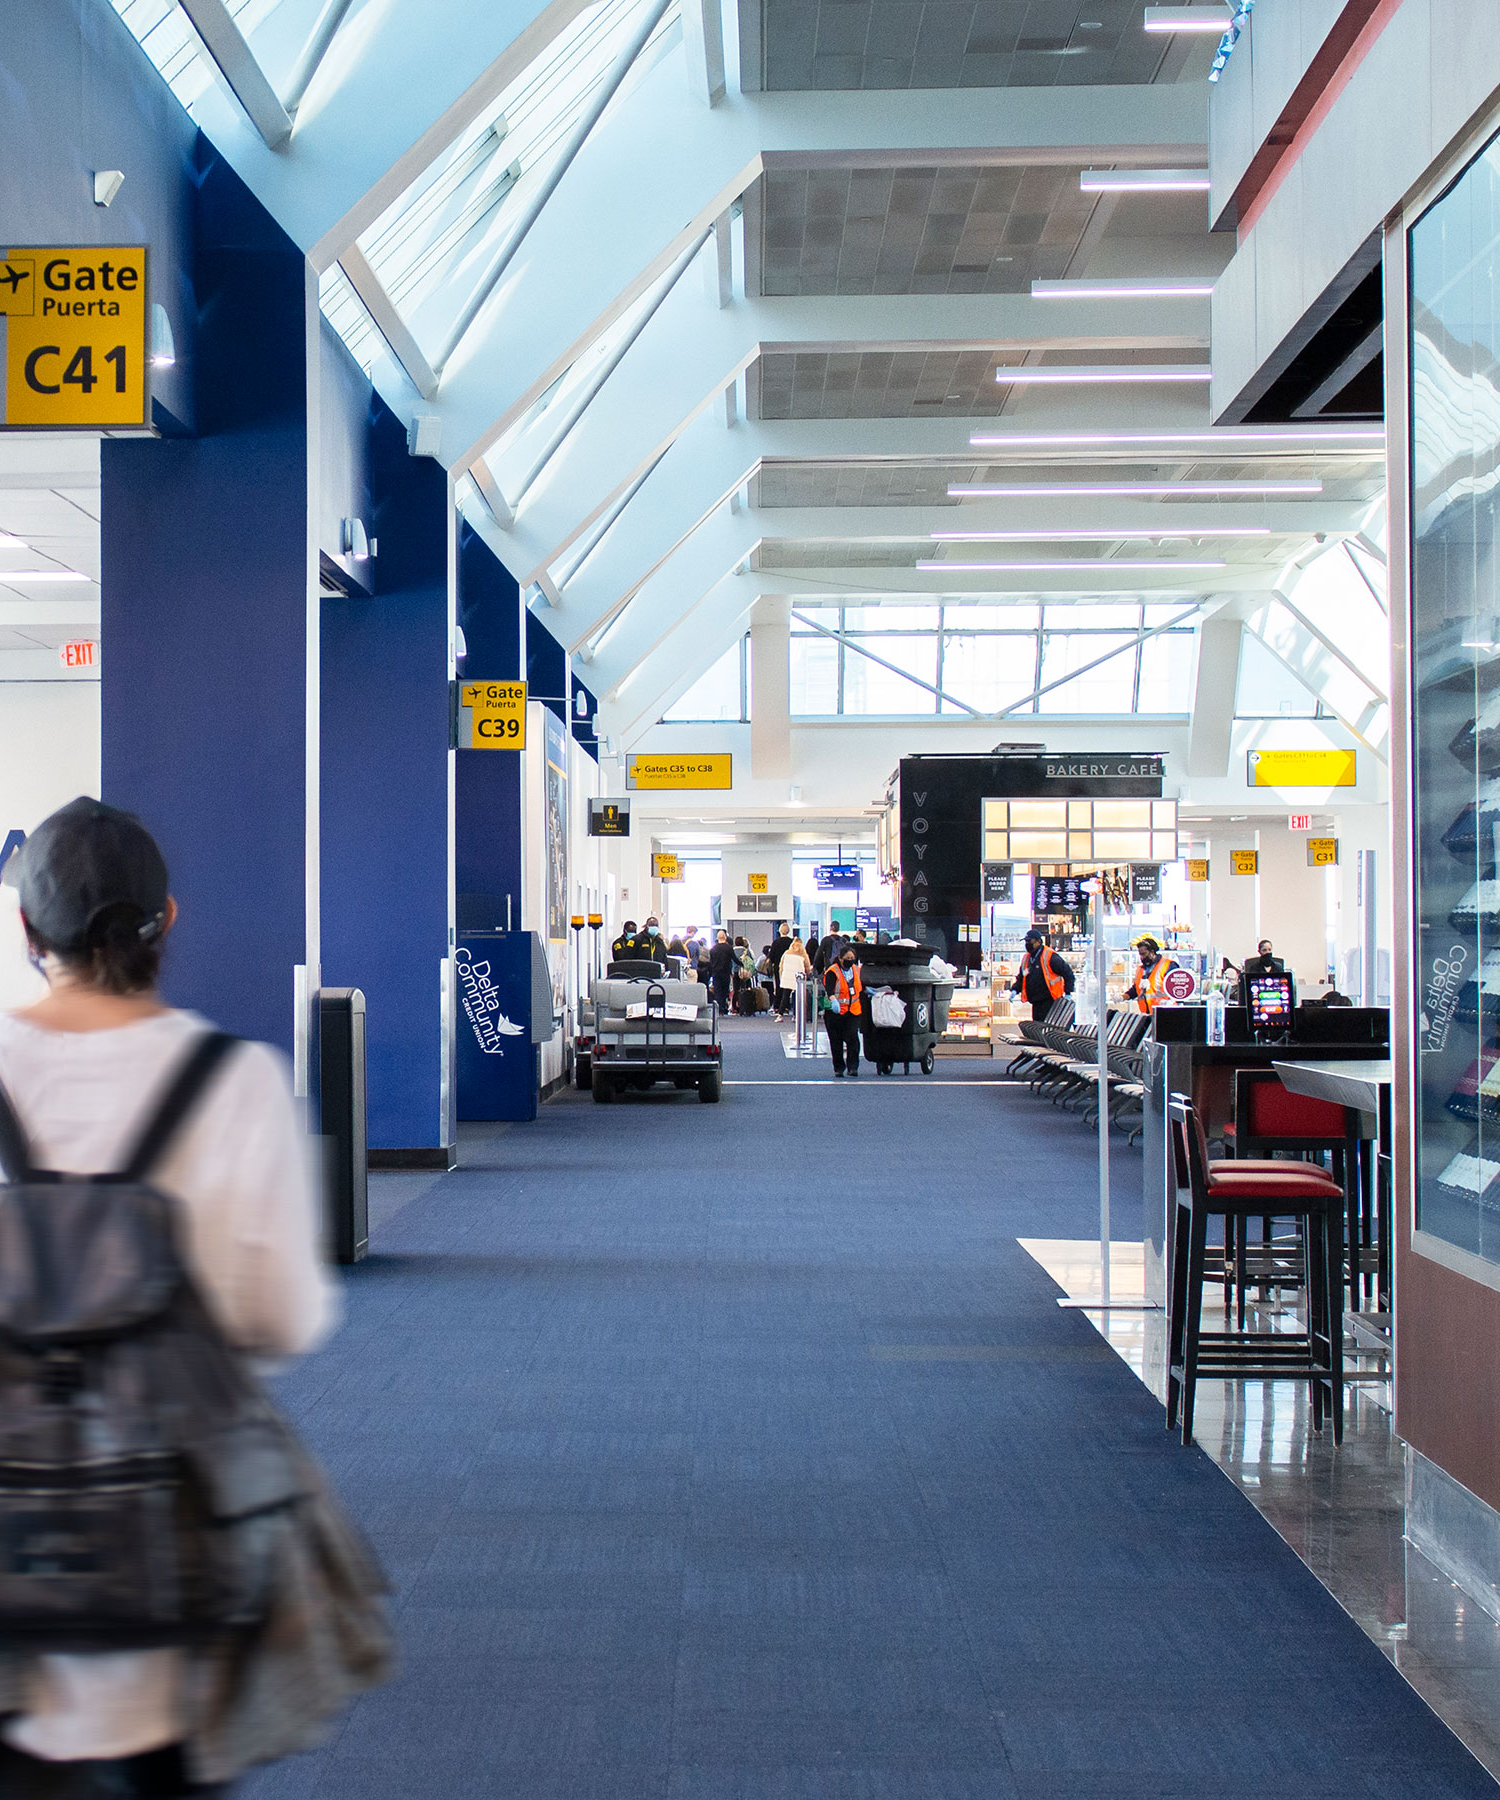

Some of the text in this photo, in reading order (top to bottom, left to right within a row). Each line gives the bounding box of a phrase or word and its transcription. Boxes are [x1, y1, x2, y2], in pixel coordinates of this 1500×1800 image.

[43, 258, 138, 292] Gate
[42, 297, 120, 317] Puerta
[24, 345, 126, 394] C41
[65, 643, 93, 666] EXIT
[486, 685, 523, 699] Gate
[486, 700, 516, 708] Puerta
[477, 718, 520, 738] C39
[644, 764, 713, 773] Gates C35 to C38
[1046, 762, 1159, 776] BAKERY CAFÉ
[1291, 815, 1308, 829] EXIT
[912, 792, 930, 939] VOYAGE
[1316, 853, 1334, 862] C31
[660, 866, 676, 874] C38
[1238, 863, 1254, 871] C32
[471, 960, 500, 1012] Delta
[462, 997, 486, 1049] CREDIT UNION
